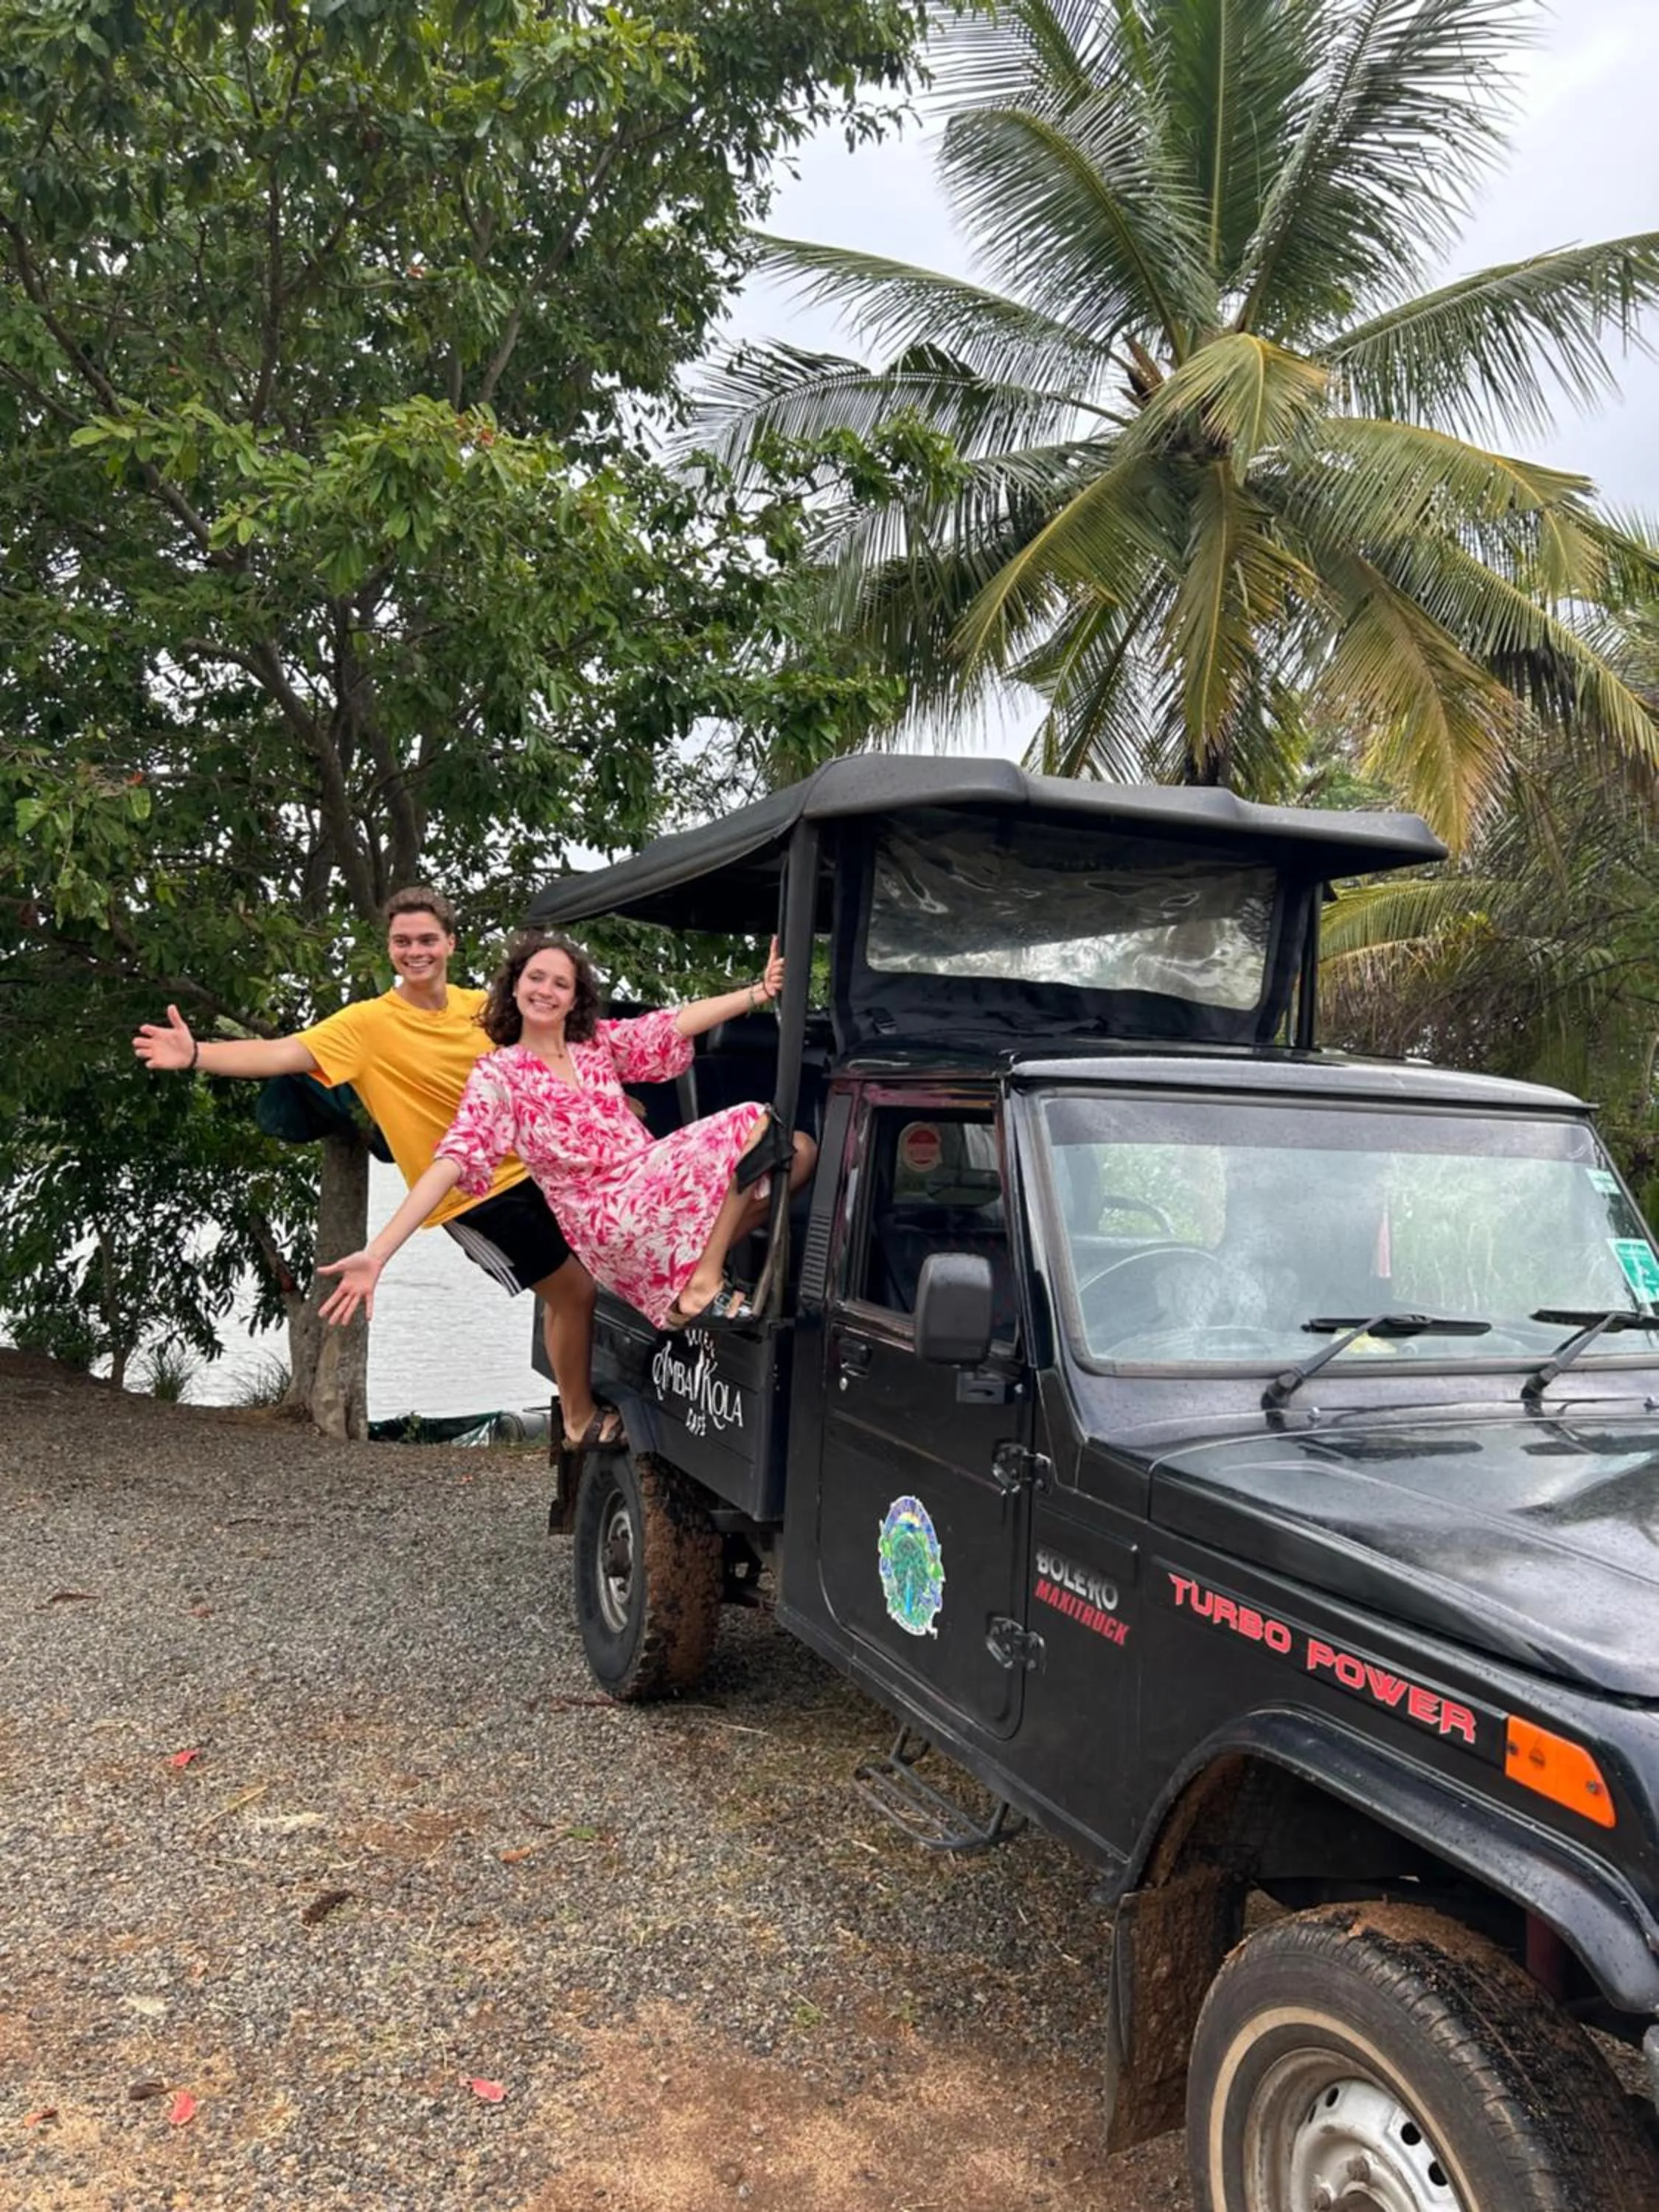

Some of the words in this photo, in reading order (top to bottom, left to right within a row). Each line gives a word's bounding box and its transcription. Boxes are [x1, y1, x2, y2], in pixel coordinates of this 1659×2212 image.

[1034, 1577, 1130, 1646] MAXITRUCK
[1036, 1550, 1119, 1610] BOLERO
[1168, 1573, 1292, 1654] TURBO
[1307, 1638, 1475, 1744] POWER
